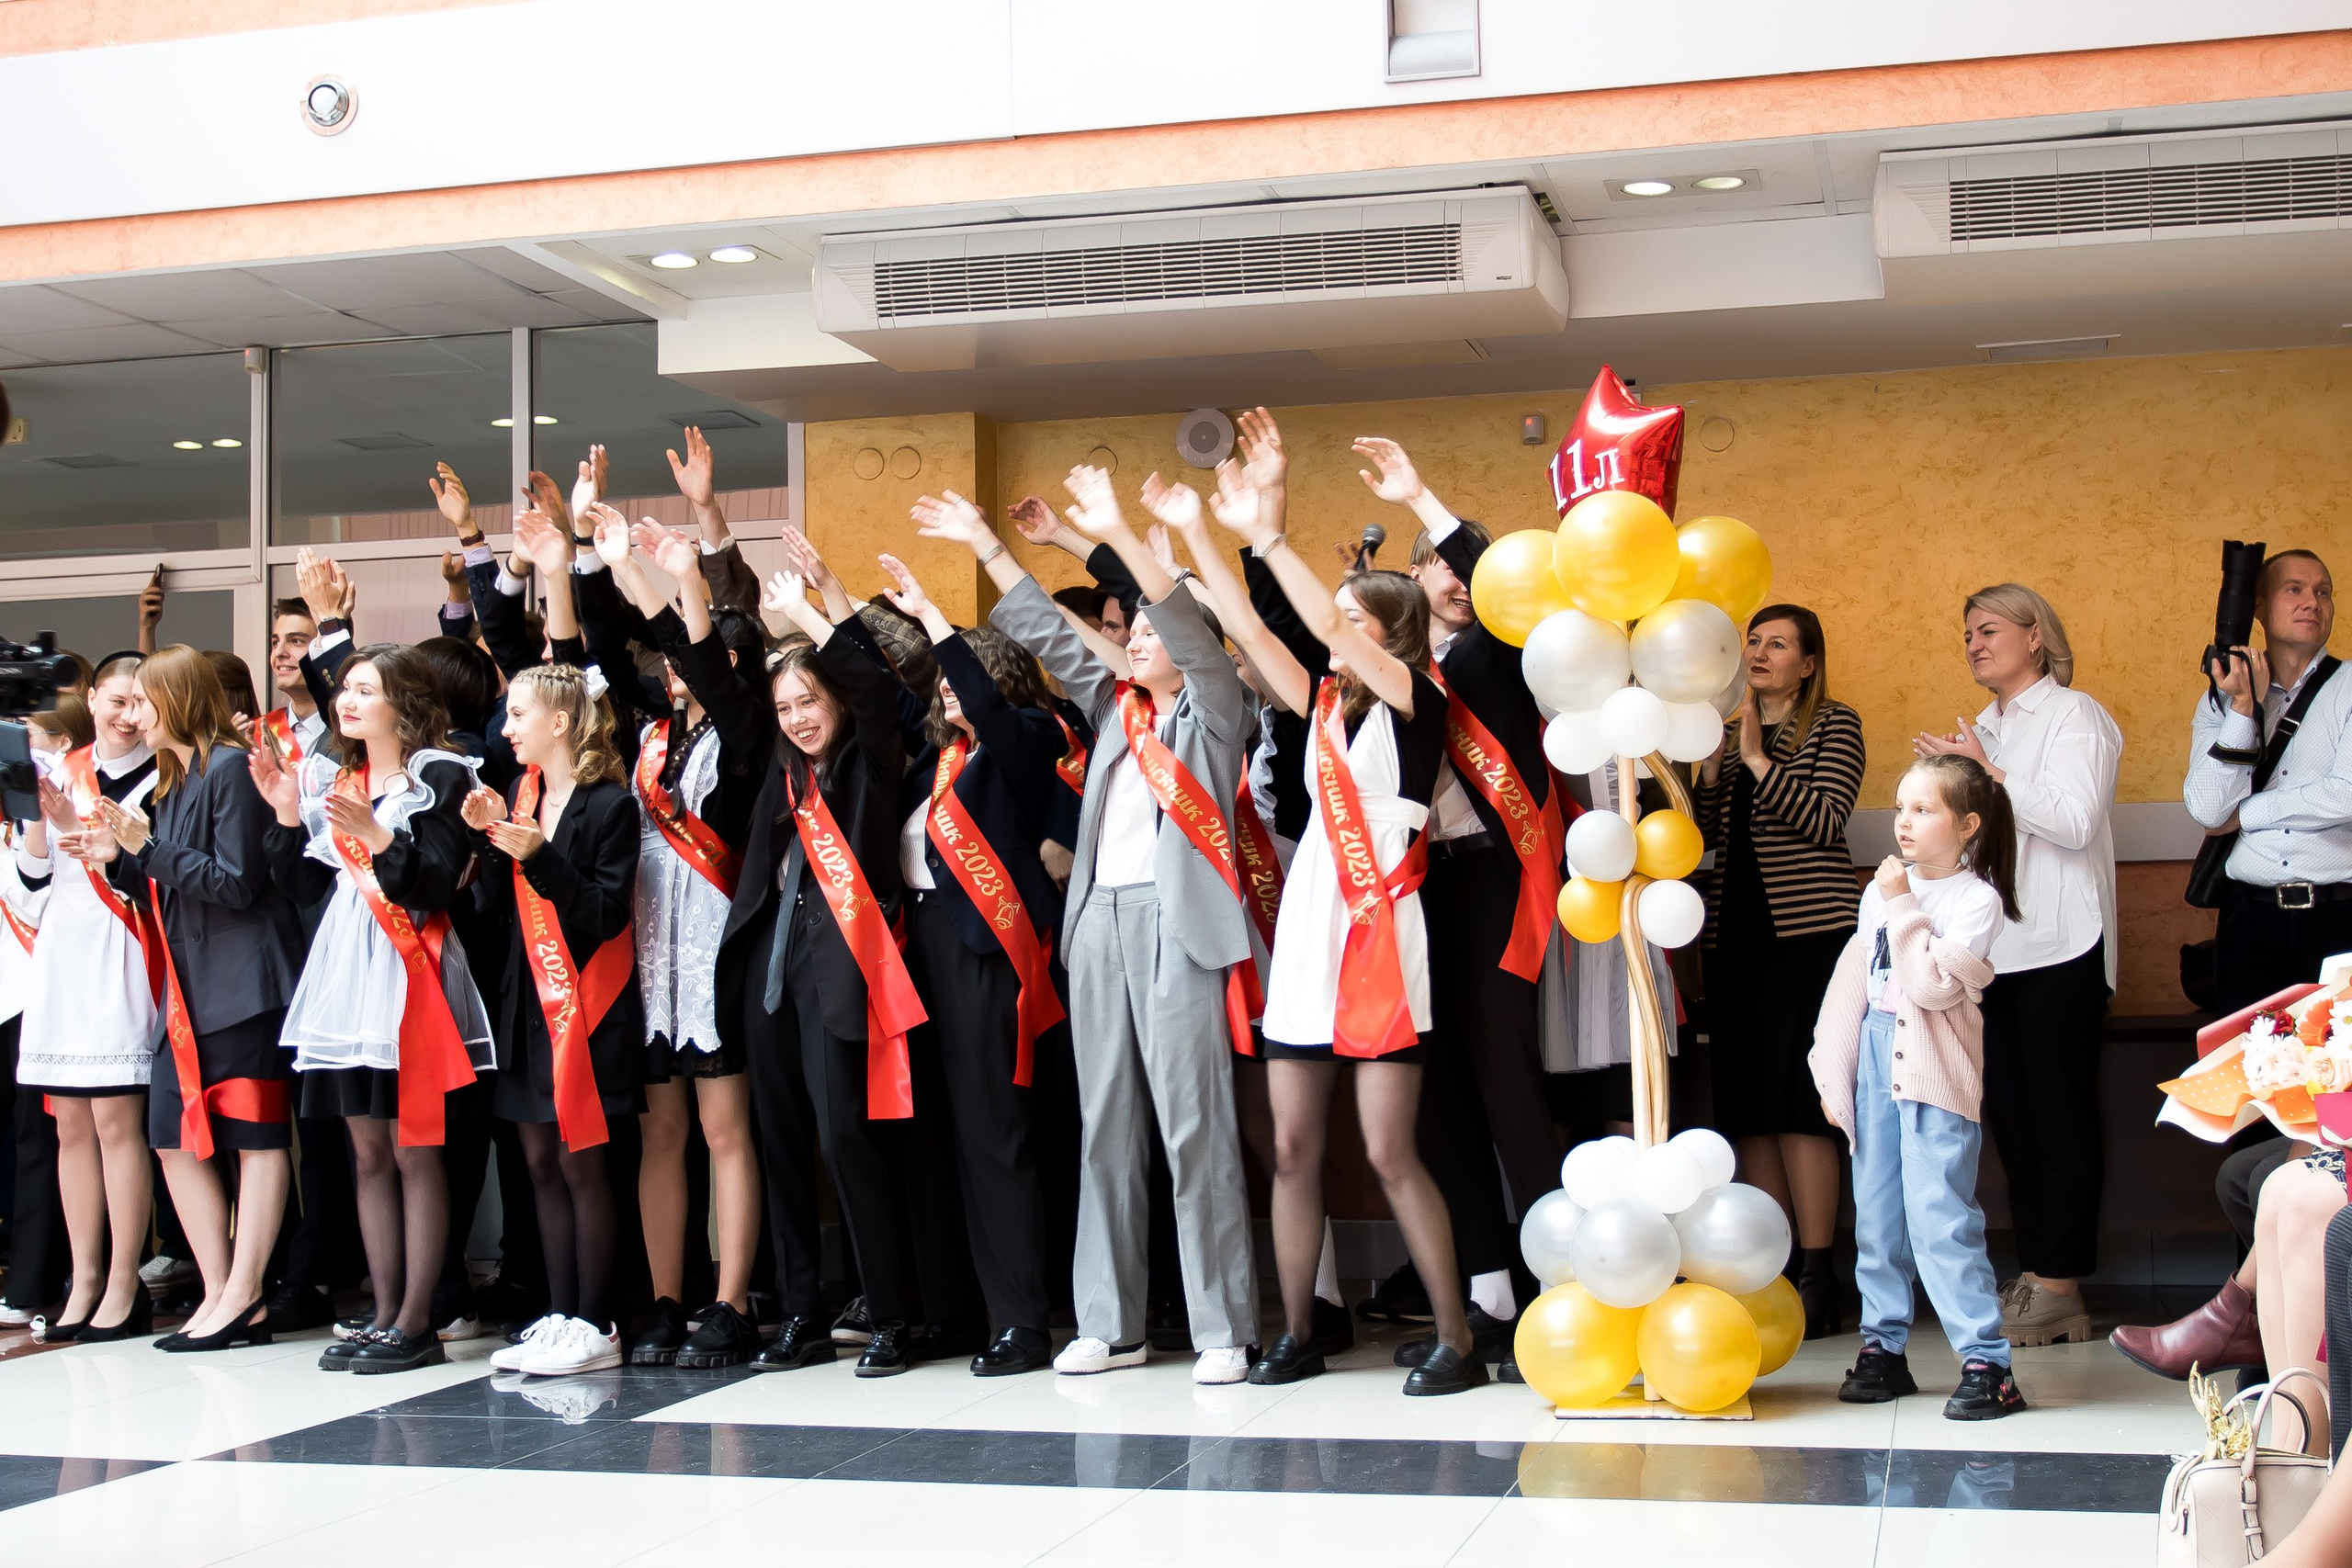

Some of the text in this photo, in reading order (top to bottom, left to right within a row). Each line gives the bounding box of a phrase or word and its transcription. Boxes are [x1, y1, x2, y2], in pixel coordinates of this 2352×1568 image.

[1482, 761, 1529, 819] 2023
[810, 832, 854, 889] 2023
[954, 840, 1005, 897] 2023
[1339, 826, 1377, 888] 2023
[537, 939, 573, 998] 2023
